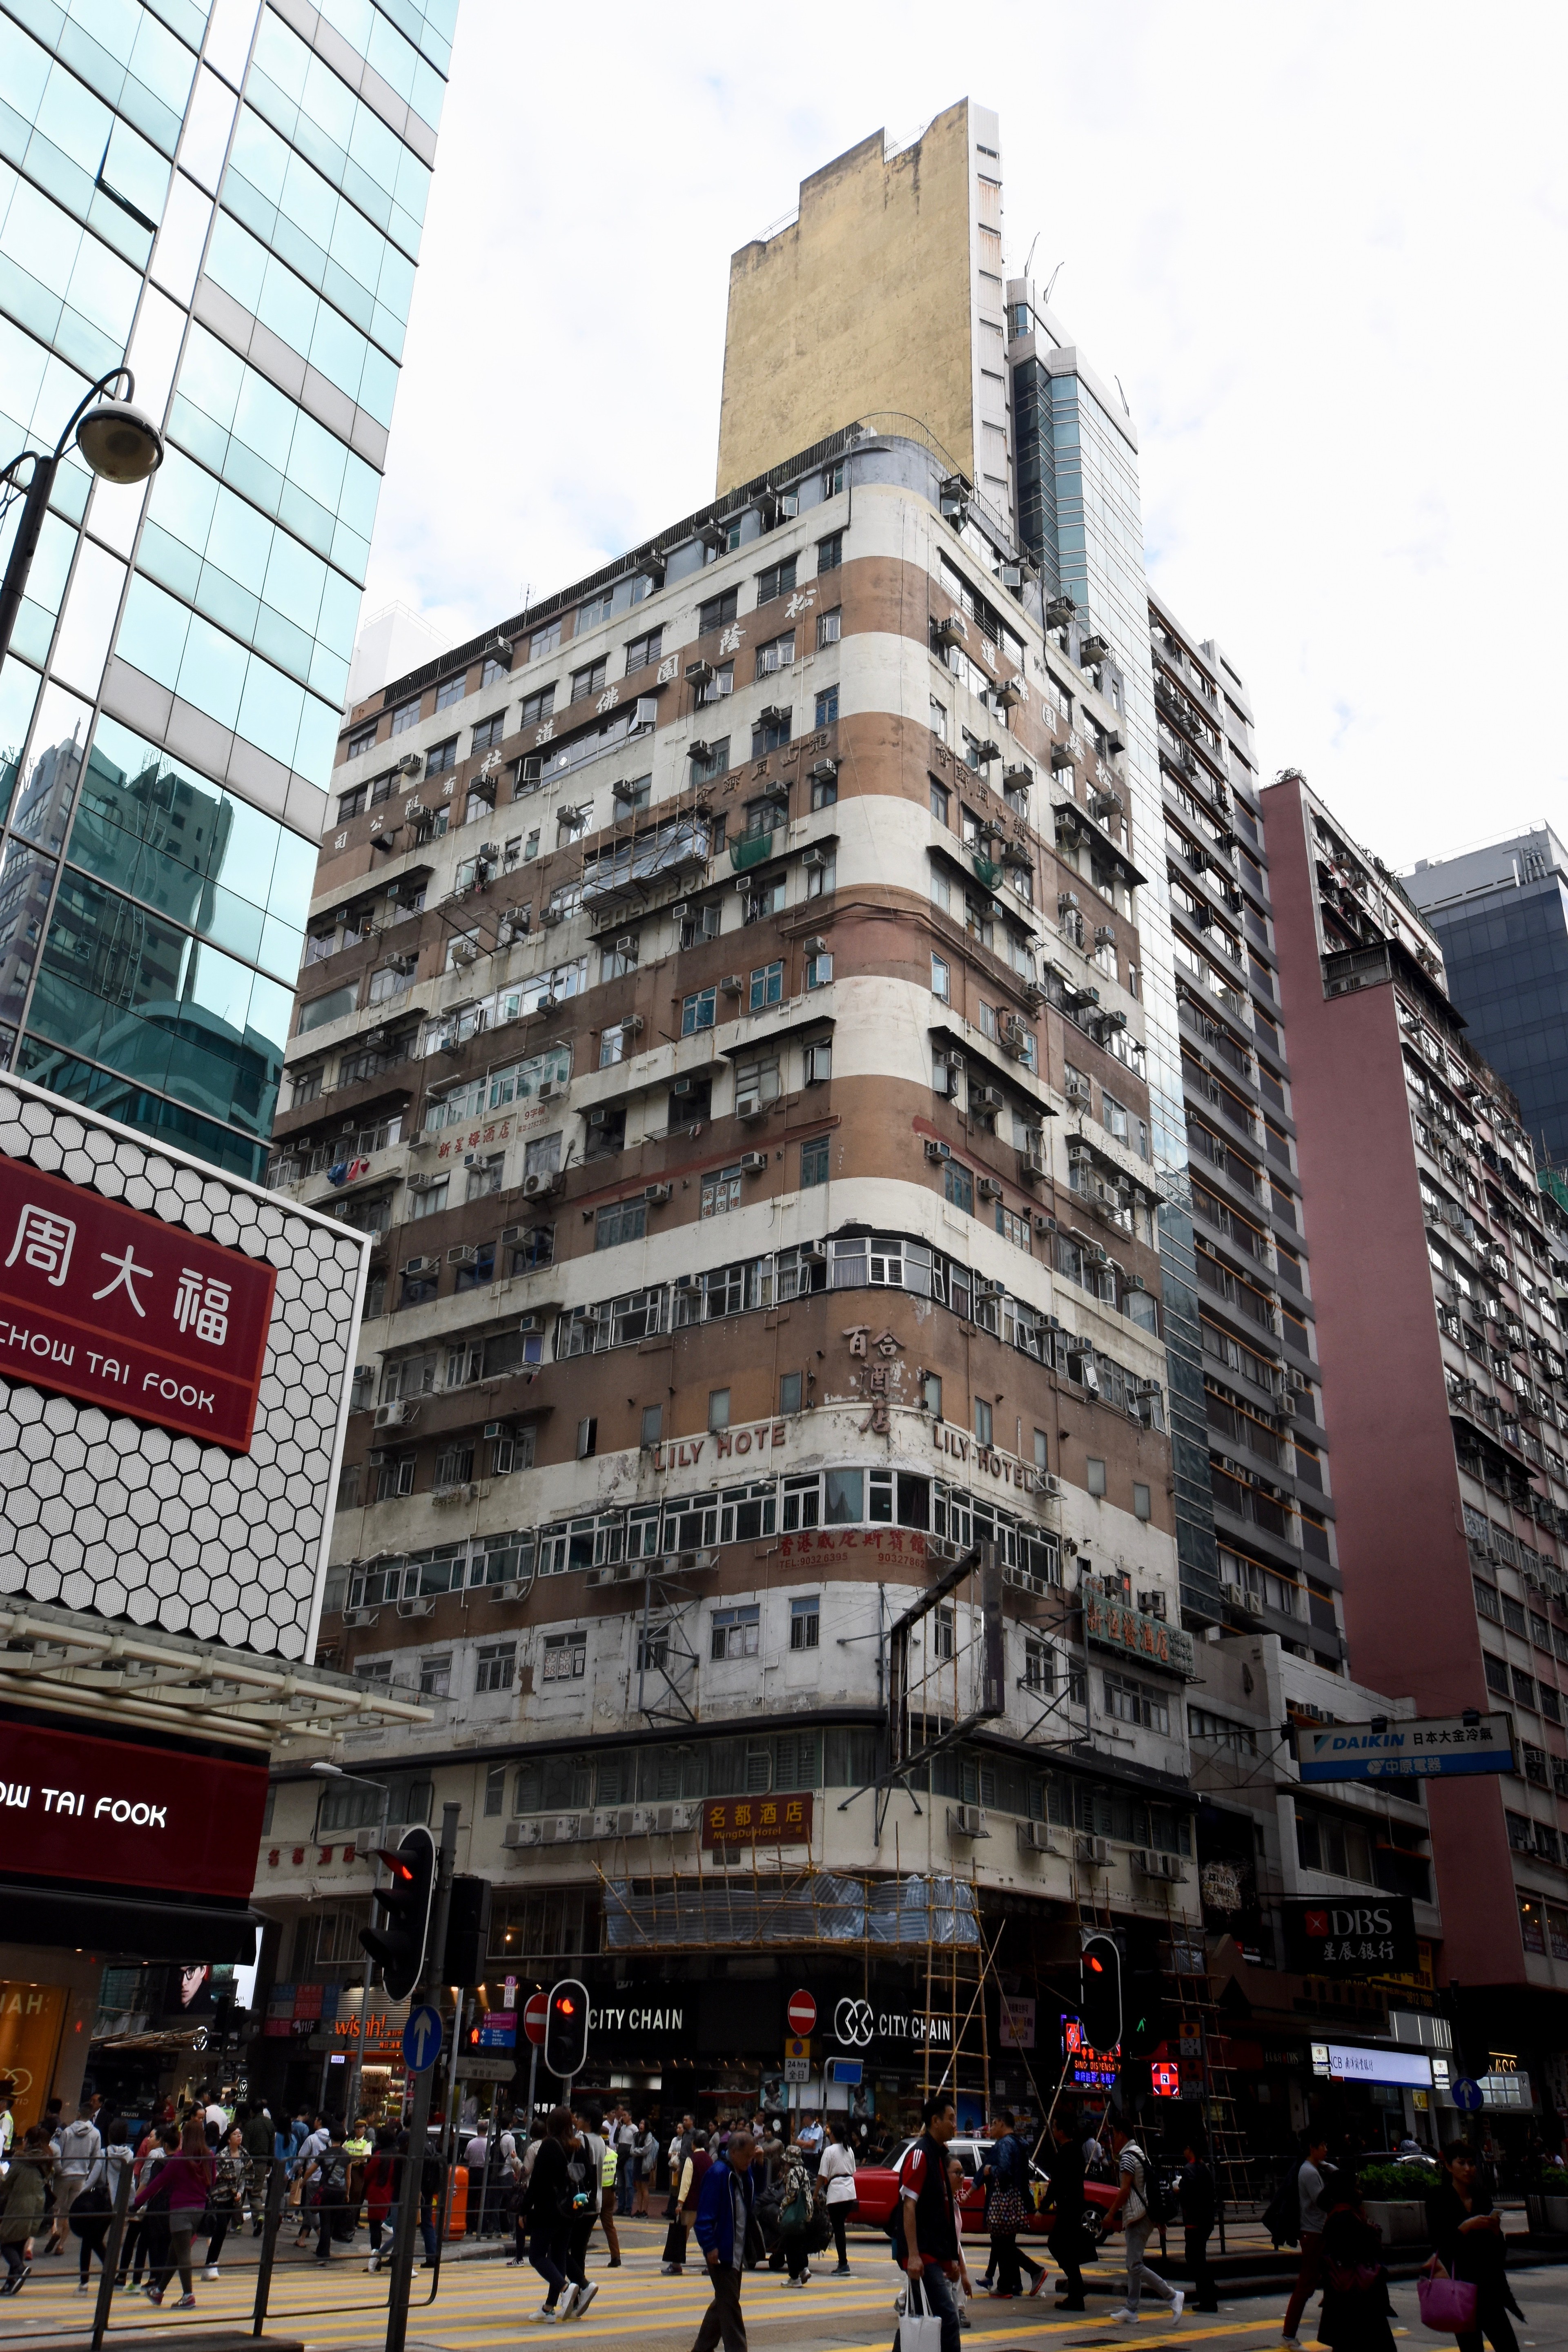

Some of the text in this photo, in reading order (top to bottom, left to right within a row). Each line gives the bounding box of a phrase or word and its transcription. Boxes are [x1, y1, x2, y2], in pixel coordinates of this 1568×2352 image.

[716, 1185, 726, 1213] 酒店
[730, 1181, 739, 1208] 7樓
[5, 1203, 232, 1346] 周大福
[87, 1350, 130, 1385] TAI
[143, 1372, 215, 1414] FOOK
[654, 1423, 786, 1471] LILY HOTE
[933, 1424, 1033, 1492] LILY HOTEL
[779, 1530, 925, 1555] 香港威尼斯賓館
[878, 1553, 925, 1568] 90327862
[1332, 1734, 1404, 1750] DAIKIN
[1413, 1727, 1493, 1746] 日本大金冷氣
[1385, 1757, 1441, 1774] 中原電器
[41, 1788, 85, 1817] TAI
[94, 1797, 167, 1828] FOOK
[710, 1801, 802, 1829] 名都酒店
[754, 1826, 781, 1837] Hotel
[1331, 1909, 1393, 1936] DBS
[1323, 1940, 1394, 1961] 星展銀行
[506, 1988, 513, 2005] 旺角
[588, 2008, 683, 2030] CITY CHAIN
[879, 2014, 950, 2041] CITY CHAIN
[789, 2070, 804, 2080] 全日
[1075, 2060, 1121, 2073] SINO DISPENSAY
